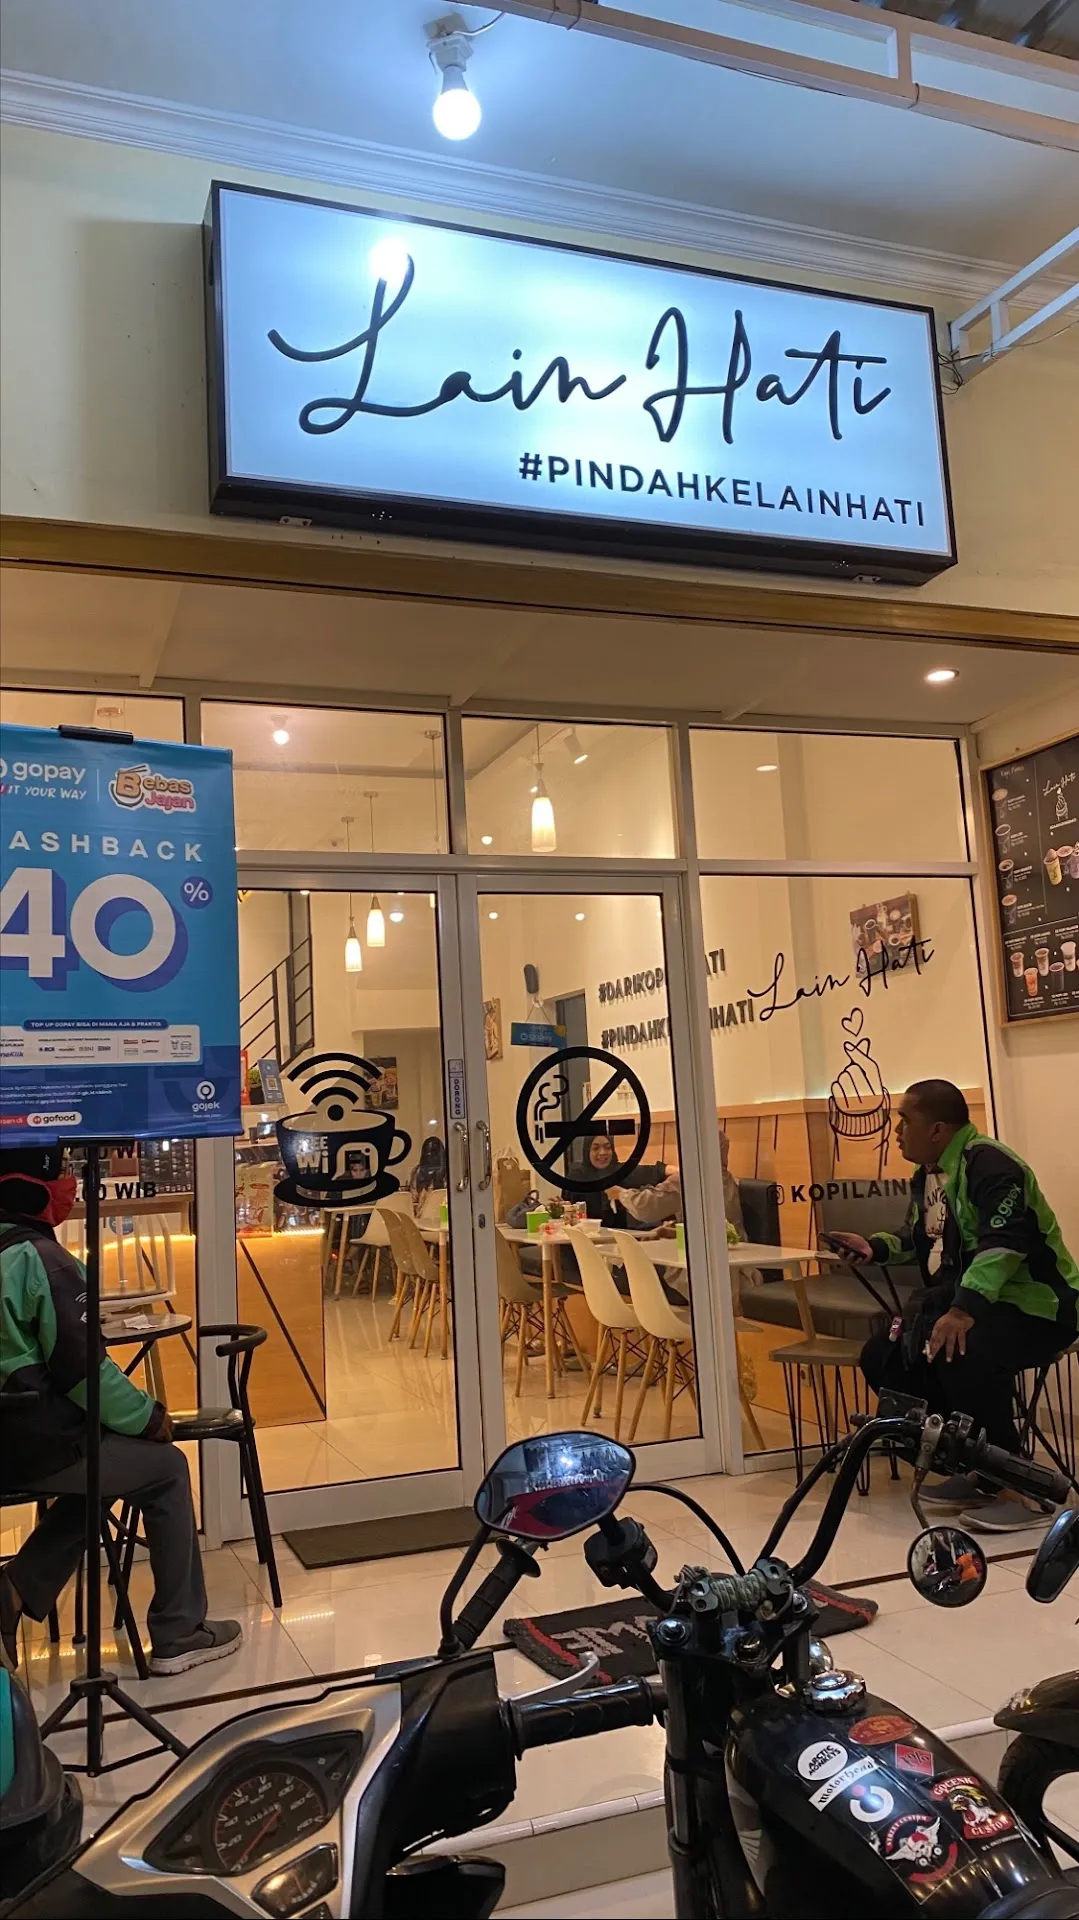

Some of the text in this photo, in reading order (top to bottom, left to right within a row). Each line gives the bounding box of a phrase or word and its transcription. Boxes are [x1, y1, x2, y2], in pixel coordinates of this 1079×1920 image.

[267, 248, 893, 445] Lain Hati
[518, 451, 926, 528] #PINDAHKELAINHATI
[13, 761, 86, 785] gopay
[113, 766, 192, 798] Bebas
[25, 786, 57, 798] YOUR
[60, 787, 87, 800] WAY
[144, 792, 195, 811] Jajan
[0, 867, 176, 980] 40
[747, 935, 935, 1021] Lain Hati
[43, 1113, 76, 1125] gofood
[192, 1101, 220, 1112] gojek
[115, 1182, 157, 1199] WIB
[791, 1178, 914, 1203] KOPILAIN
[808, 1745, 834, 1770] ARCTIC
[808, 1749, 842, 1776] MONKEYS
